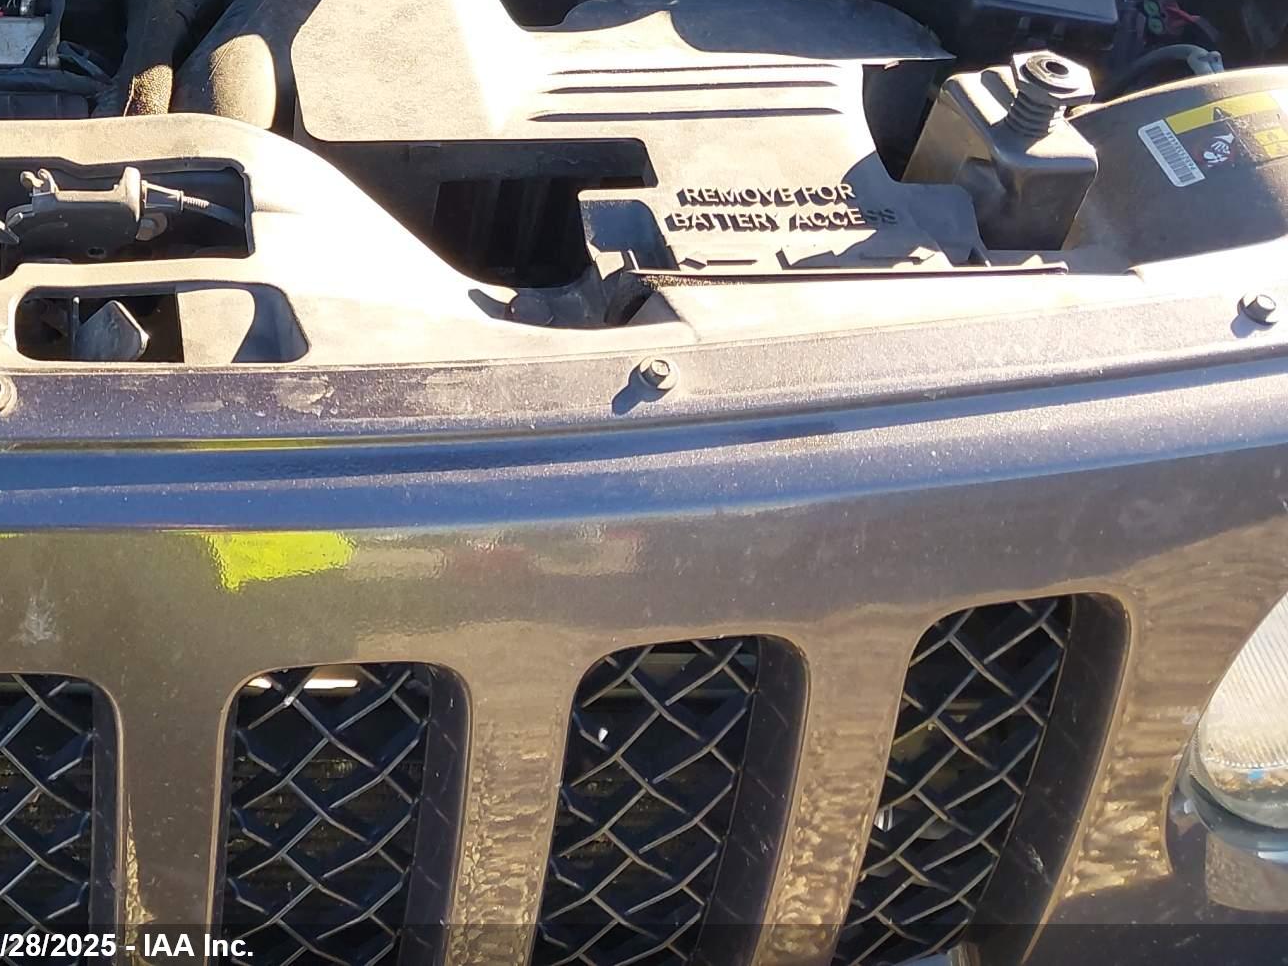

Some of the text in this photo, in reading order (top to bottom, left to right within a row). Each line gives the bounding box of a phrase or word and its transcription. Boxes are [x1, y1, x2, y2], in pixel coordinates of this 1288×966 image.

[679, 183, 856, 207] REMOVE FOR
[665, 207, 897, 232] BATTERY ACCESS
